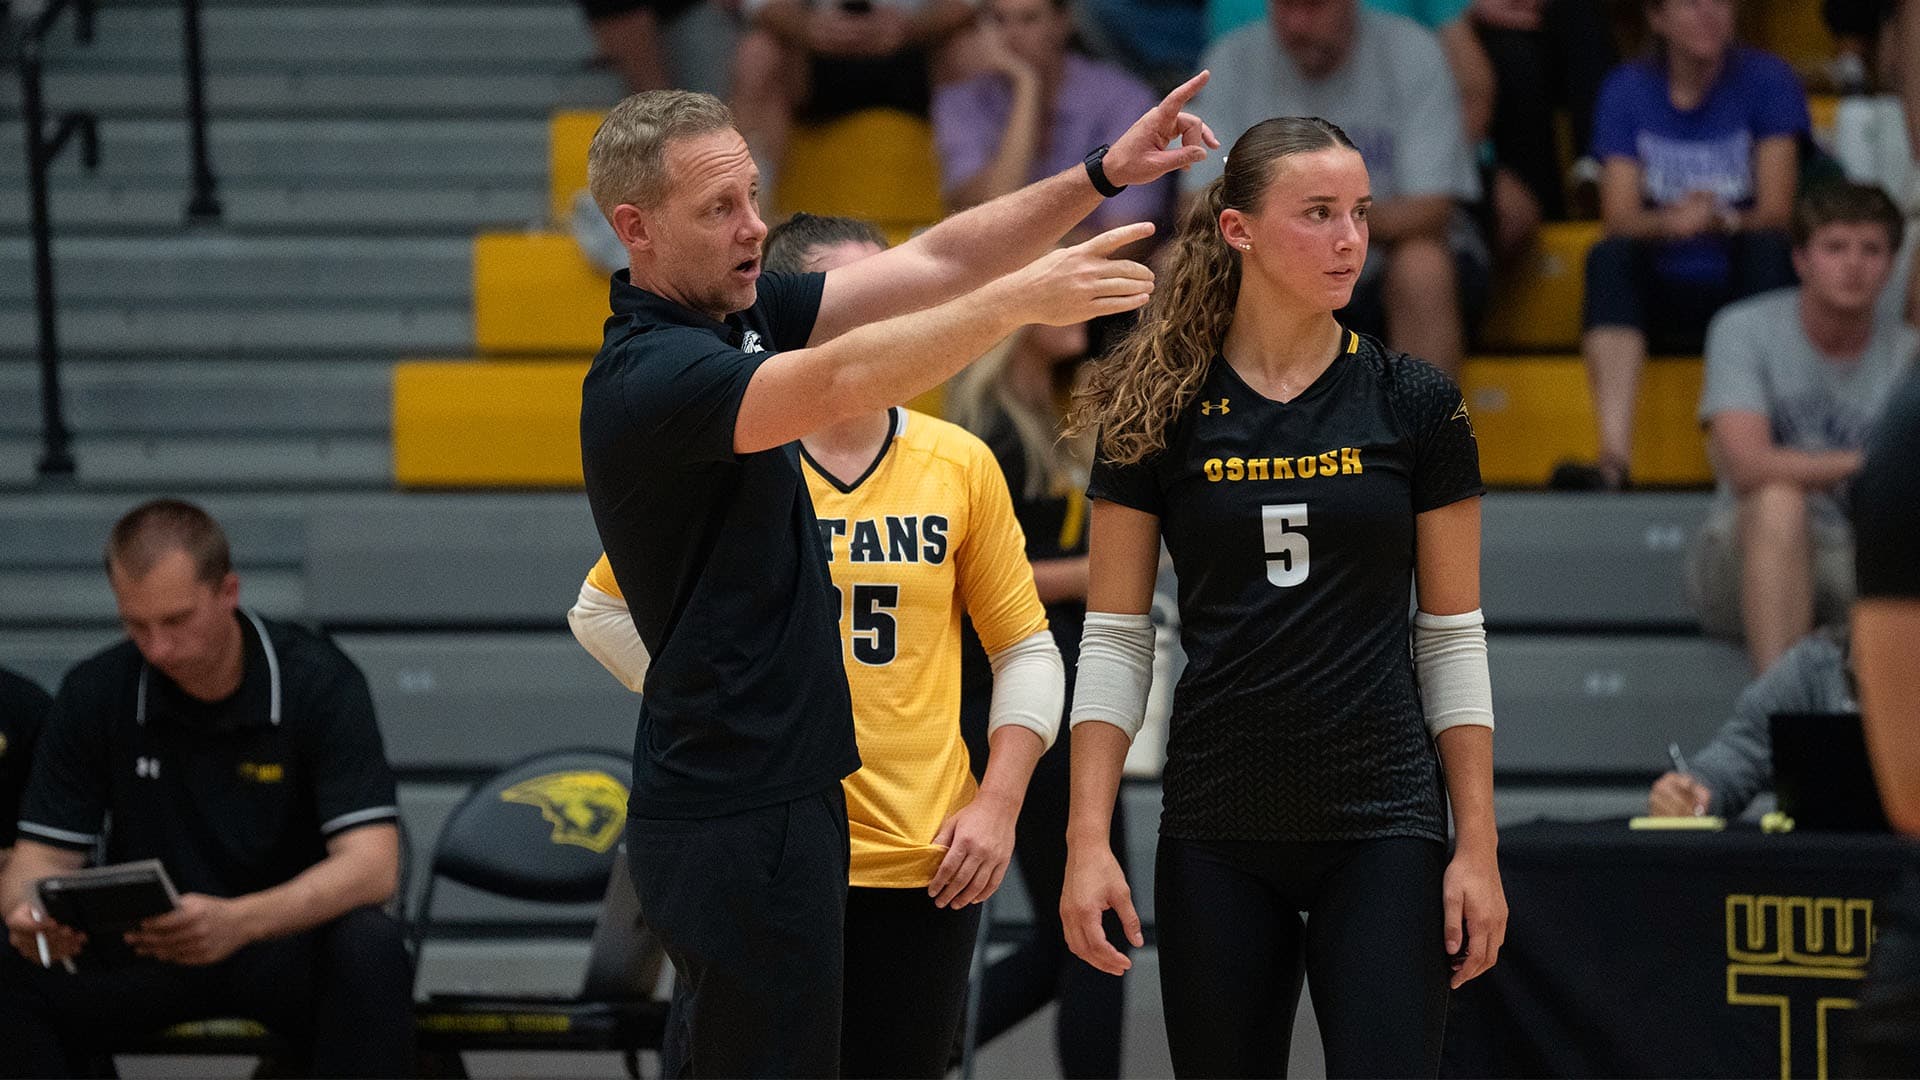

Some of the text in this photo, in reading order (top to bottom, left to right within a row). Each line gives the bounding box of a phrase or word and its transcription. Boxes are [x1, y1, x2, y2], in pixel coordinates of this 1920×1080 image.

[1203, 447, 1363, 482] OSHKOSH
[1261, 502, 1310, 588] 5
[832, 583, 900, 667] 5
[1725, 894, 1877, 967] UW
